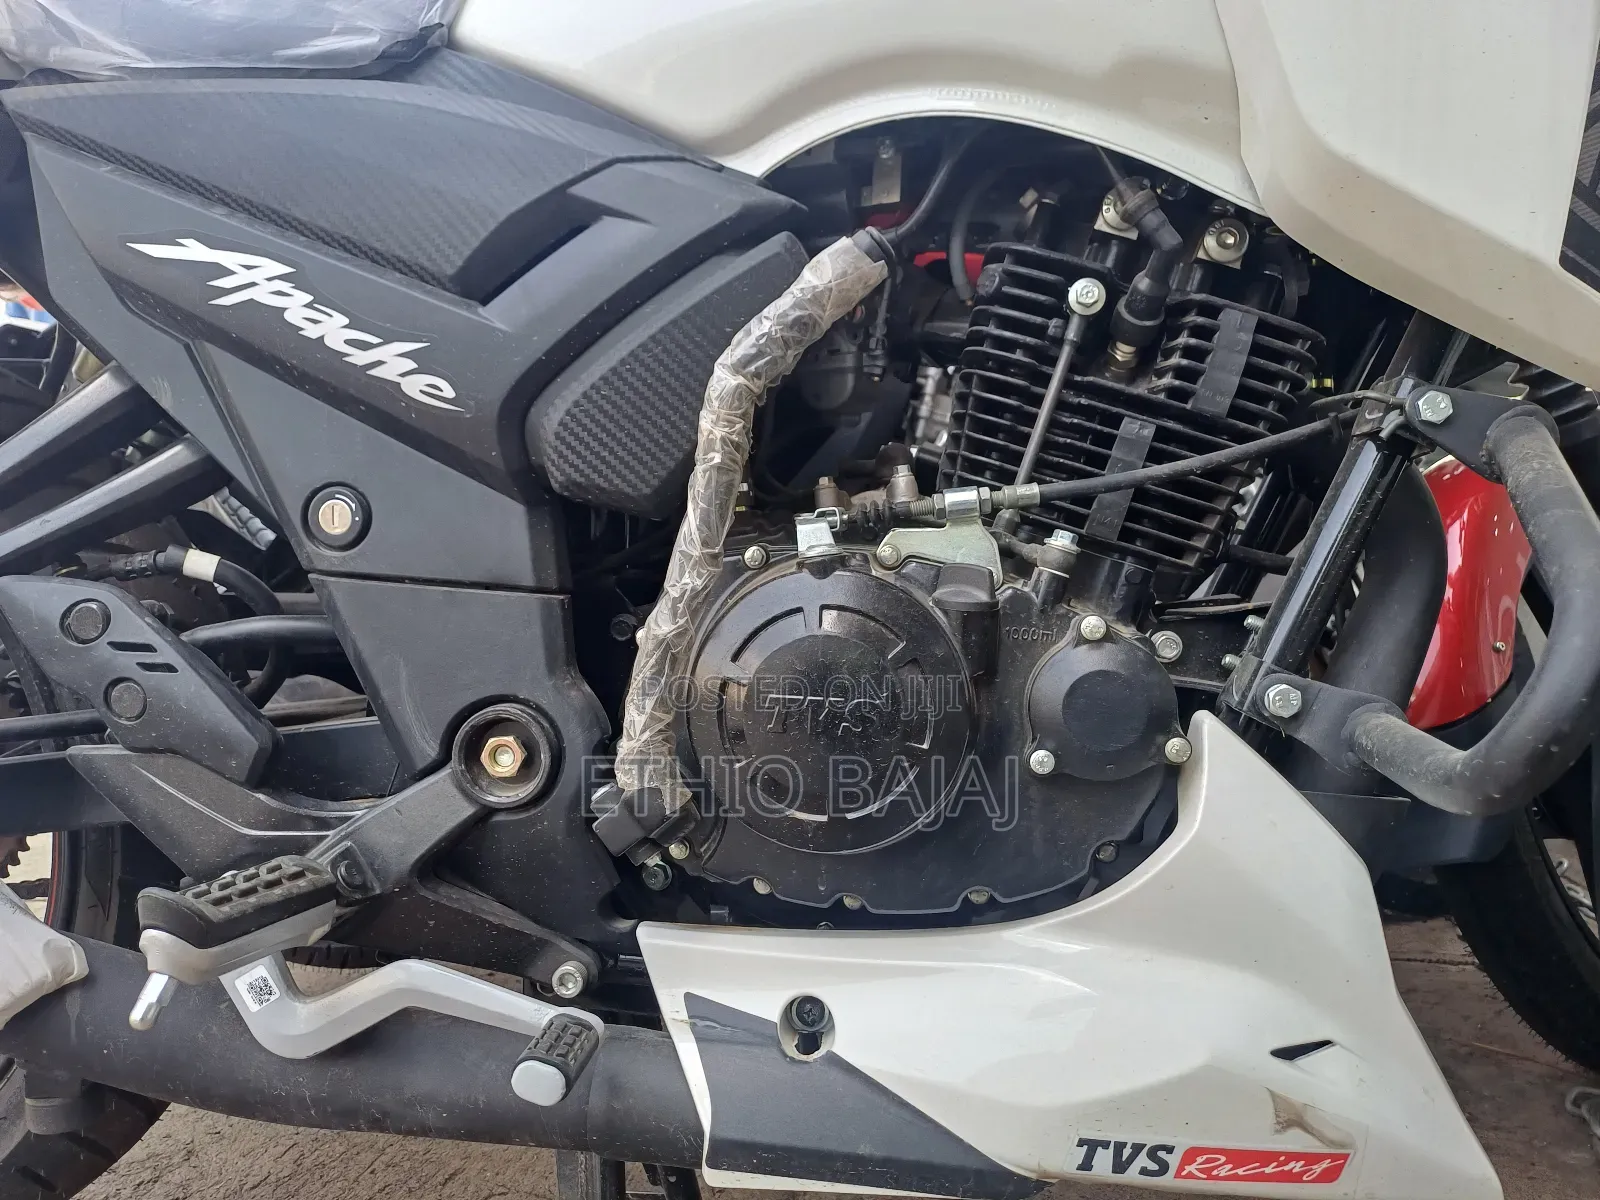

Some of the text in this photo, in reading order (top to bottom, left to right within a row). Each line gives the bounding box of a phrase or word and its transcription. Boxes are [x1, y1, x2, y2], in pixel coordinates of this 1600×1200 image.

[125, 238, 465, 412] Apache
[1005, 626, 1058, 641] 1000ml
[1076, 1137, 1345, 1181] TVS Racing
